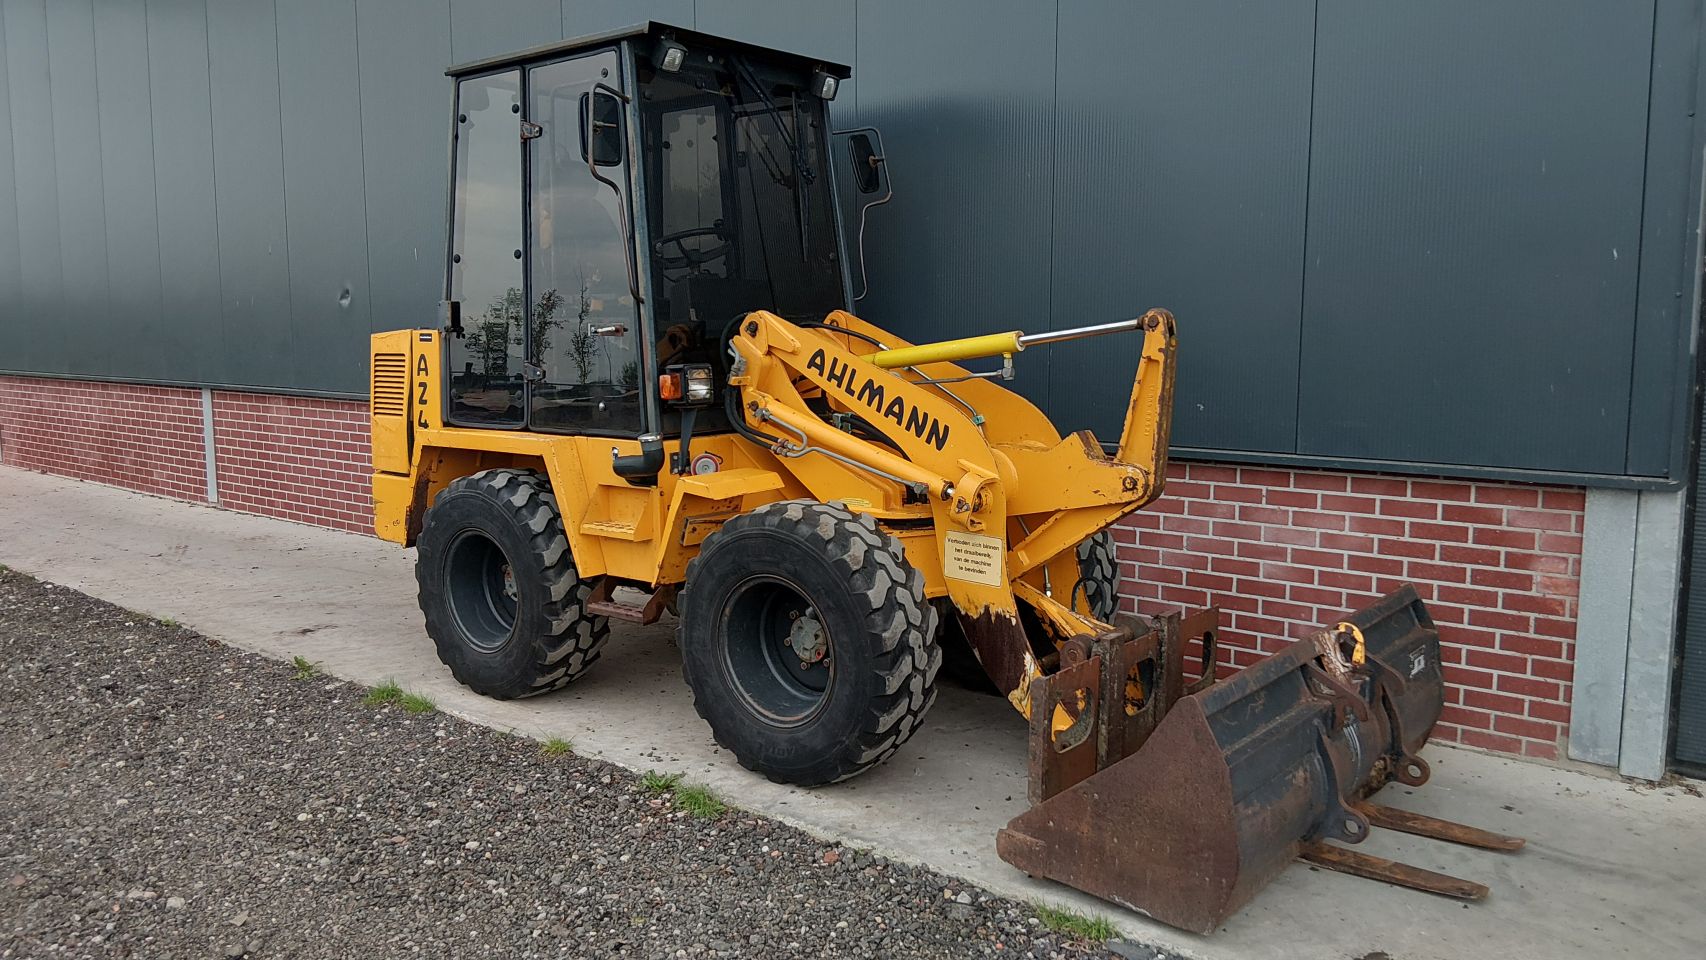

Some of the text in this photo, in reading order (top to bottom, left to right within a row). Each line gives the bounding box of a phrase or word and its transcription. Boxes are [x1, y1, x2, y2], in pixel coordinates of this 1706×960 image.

[806, 348, 950, 452] AHLMANN
[947, 537, 970, 546] Verboden
[982, 543, 1000, 551] binnen
[970, 559, 992, 568] machine
[964, 566, 987, 575] bevinden
